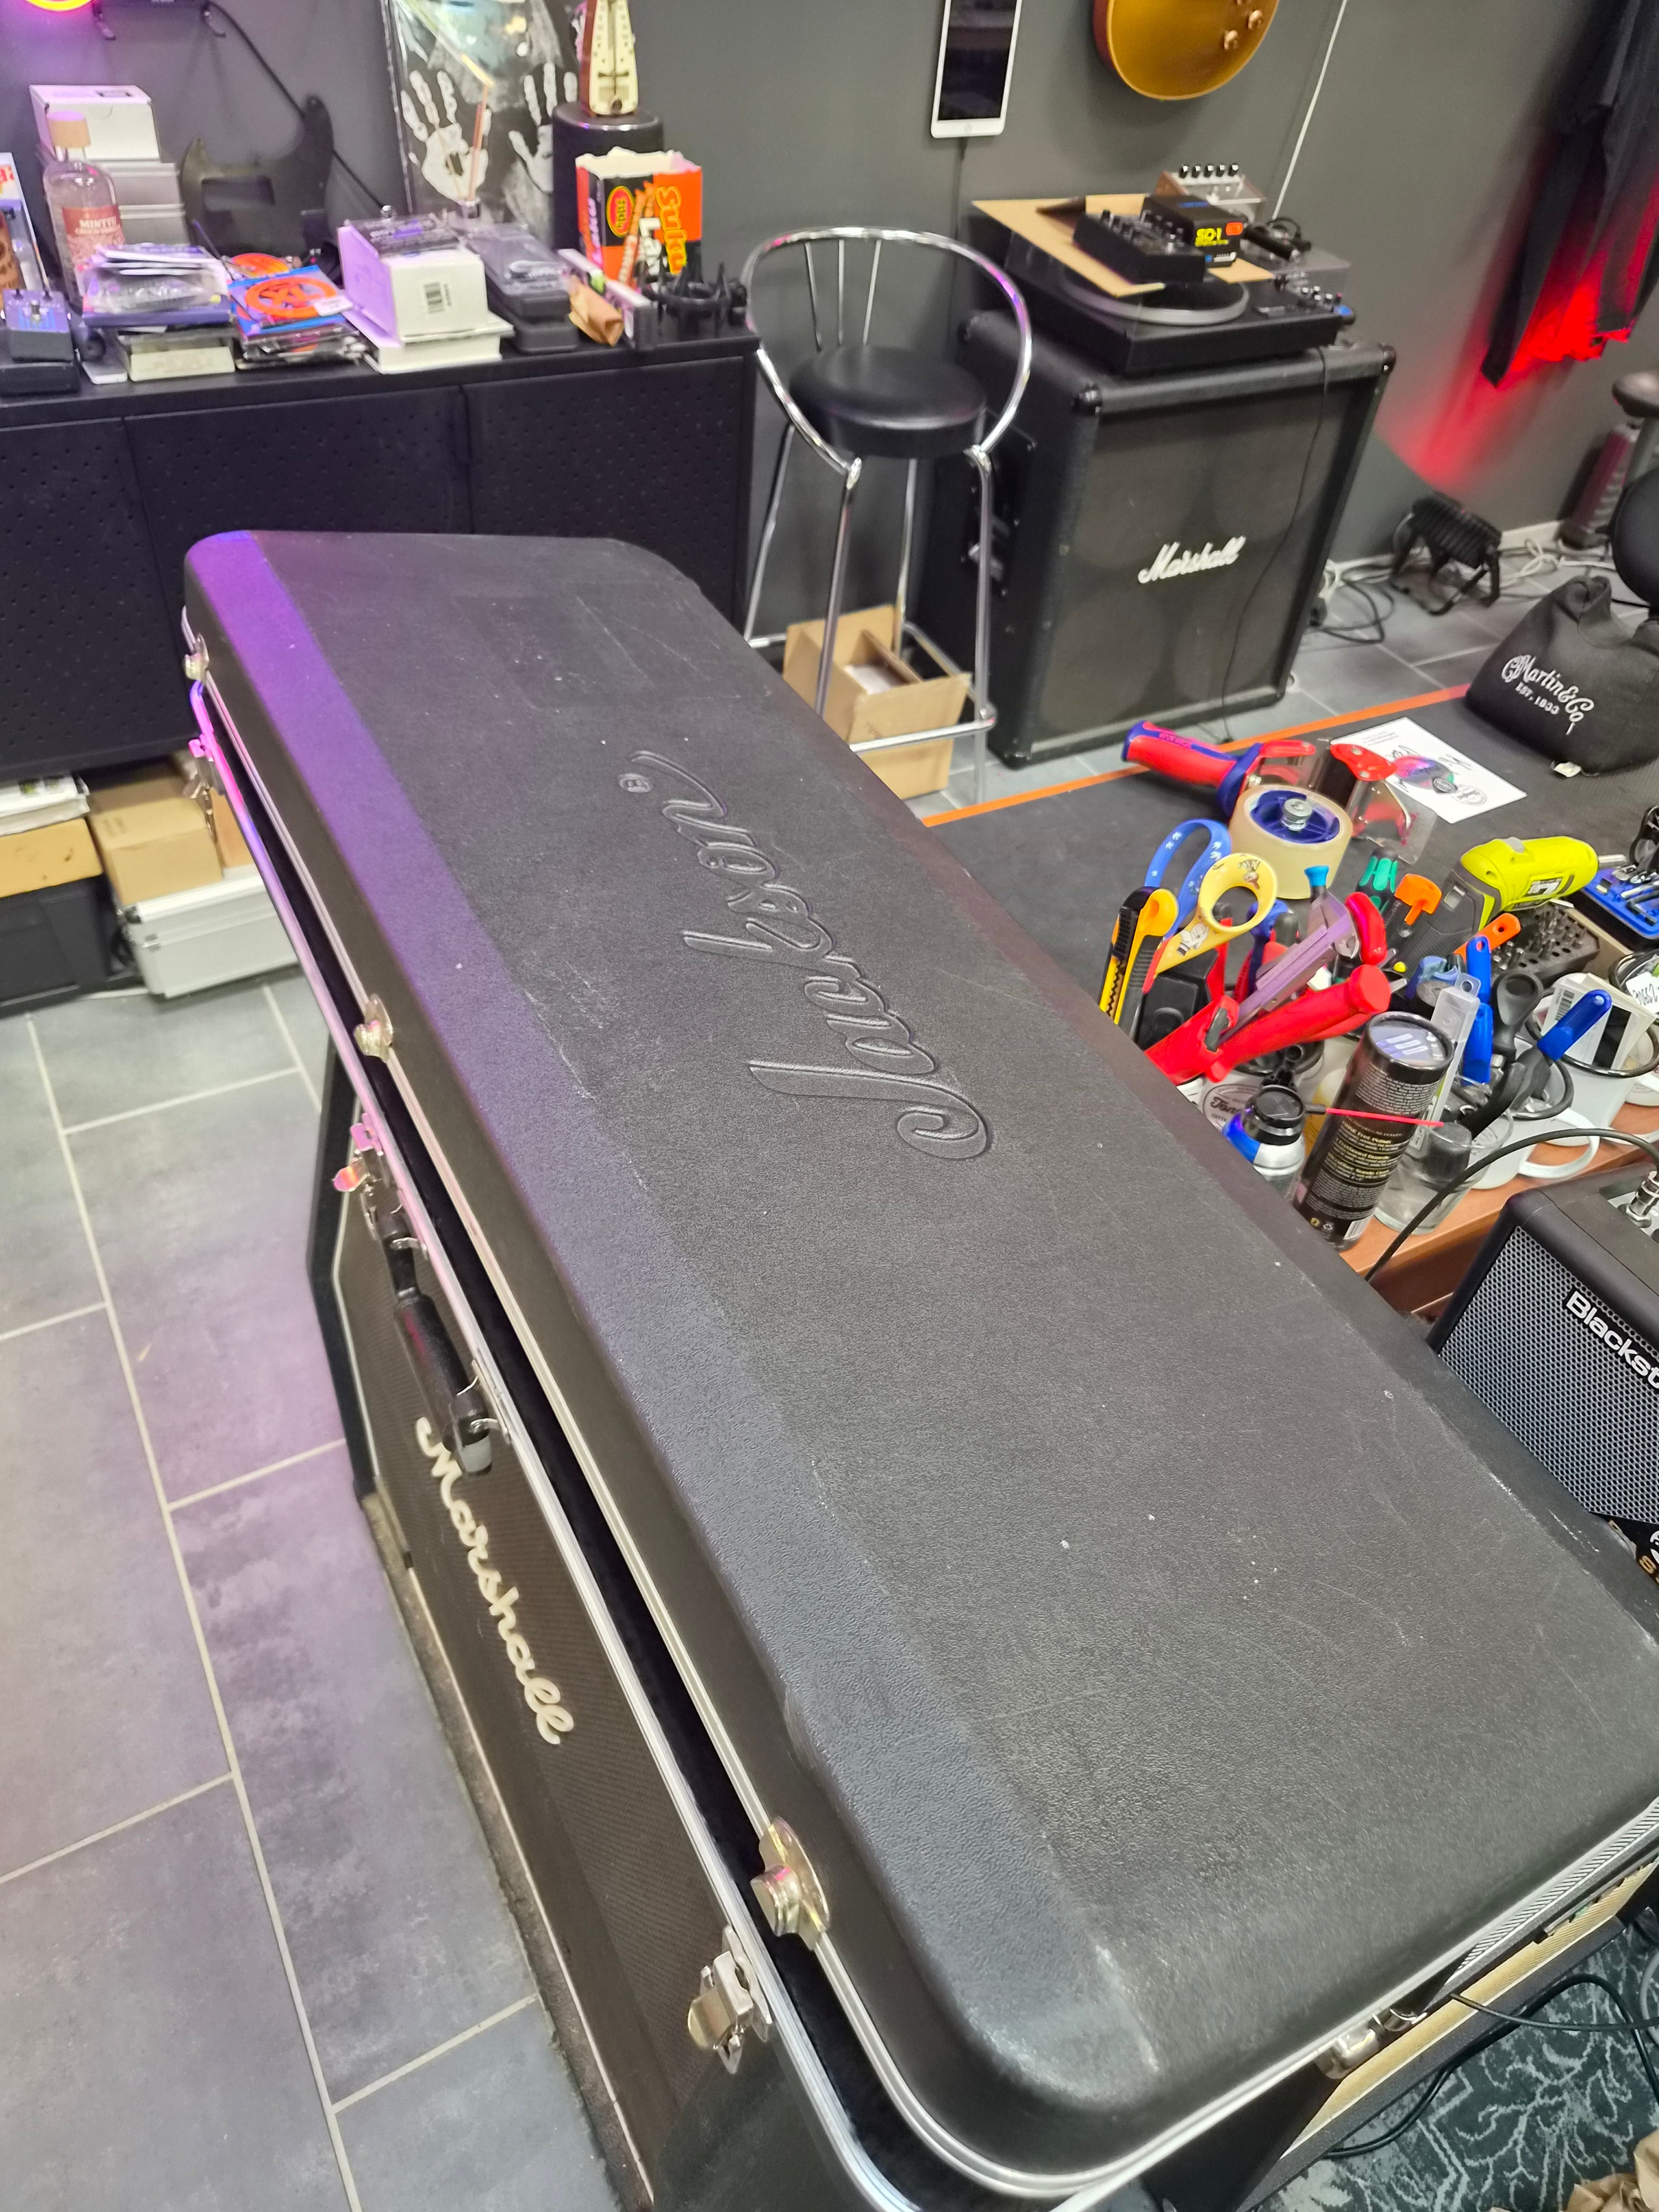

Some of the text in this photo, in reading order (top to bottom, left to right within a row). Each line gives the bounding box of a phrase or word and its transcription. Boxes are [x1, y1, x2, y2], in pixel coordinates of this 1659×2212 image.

[1138, 535, 1246, 584] Marshall
[630, 749, 993, 1160] Jackson
[416, 1416, 575, 1745] Marshall
